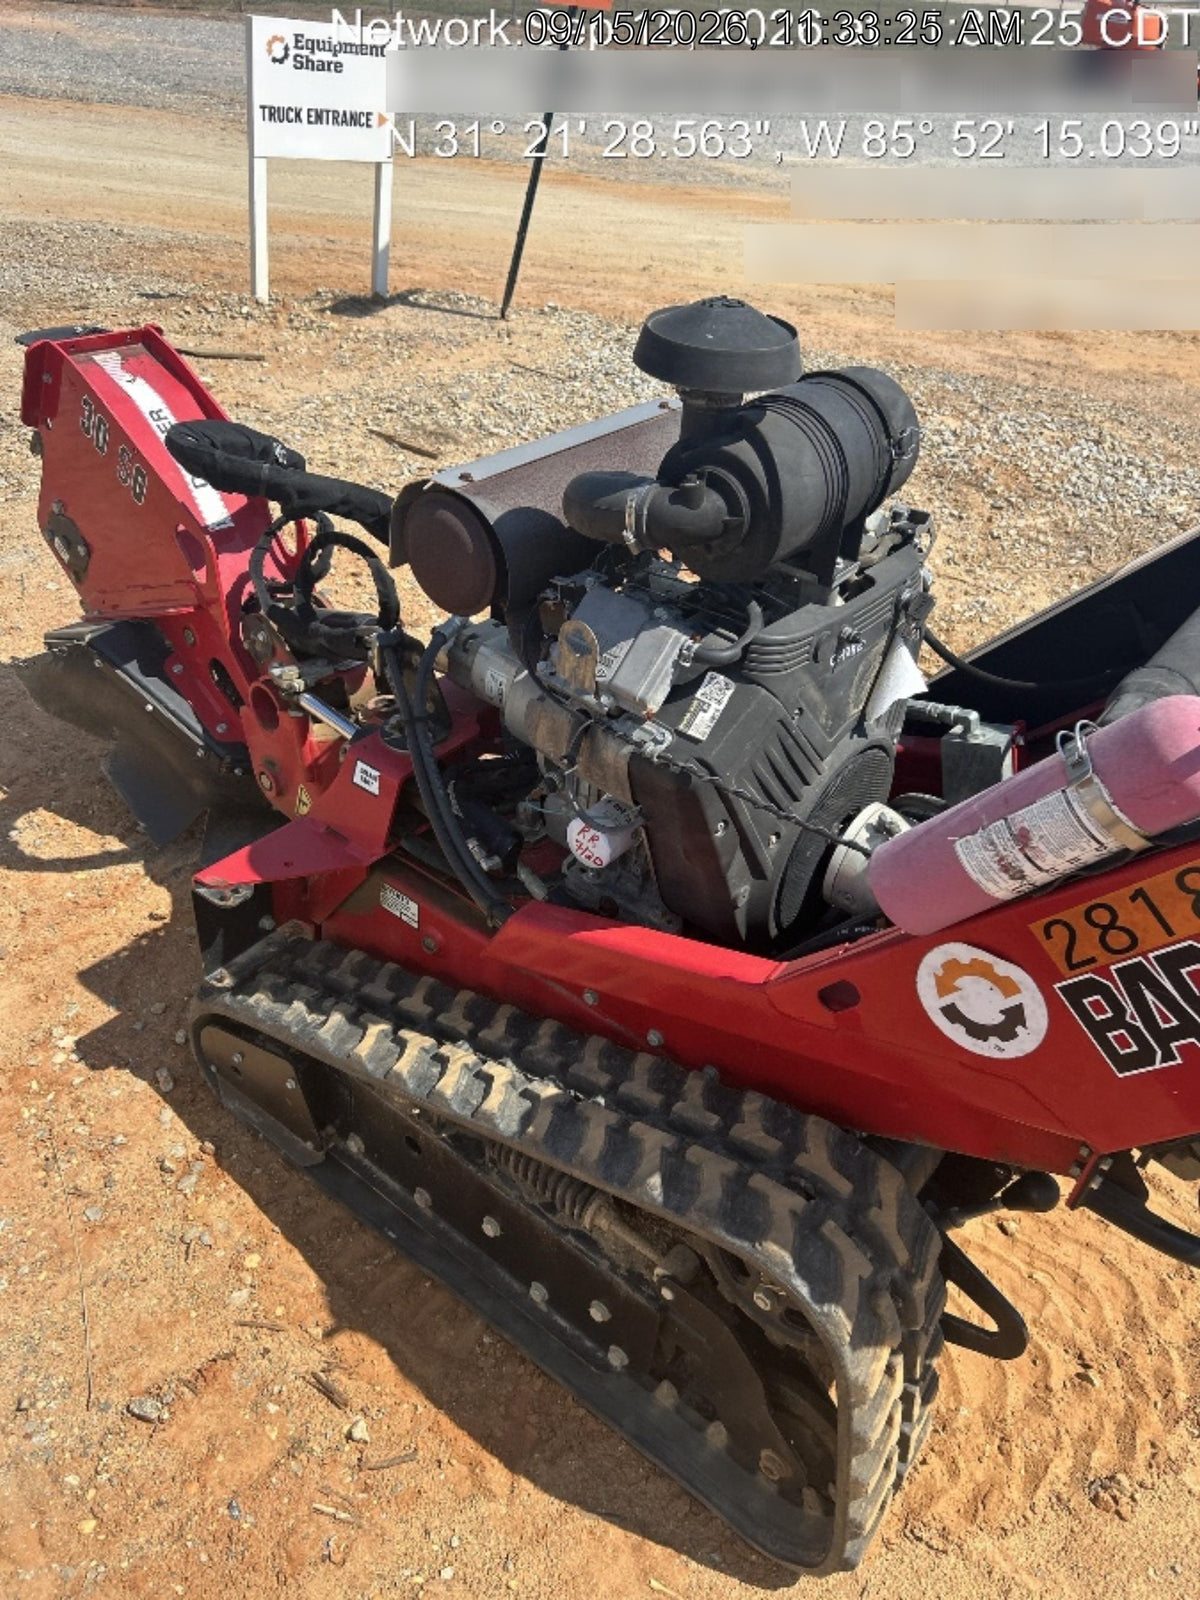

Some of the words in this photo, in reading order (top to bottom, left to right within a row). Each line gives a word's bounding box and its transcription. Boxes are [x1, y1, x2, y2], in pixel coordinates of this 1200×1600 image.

[292, 53, 344, 73] Share
[259, 104, 302, 123] TRUCK
[307, 107, 373, 128] ENTRANCE
